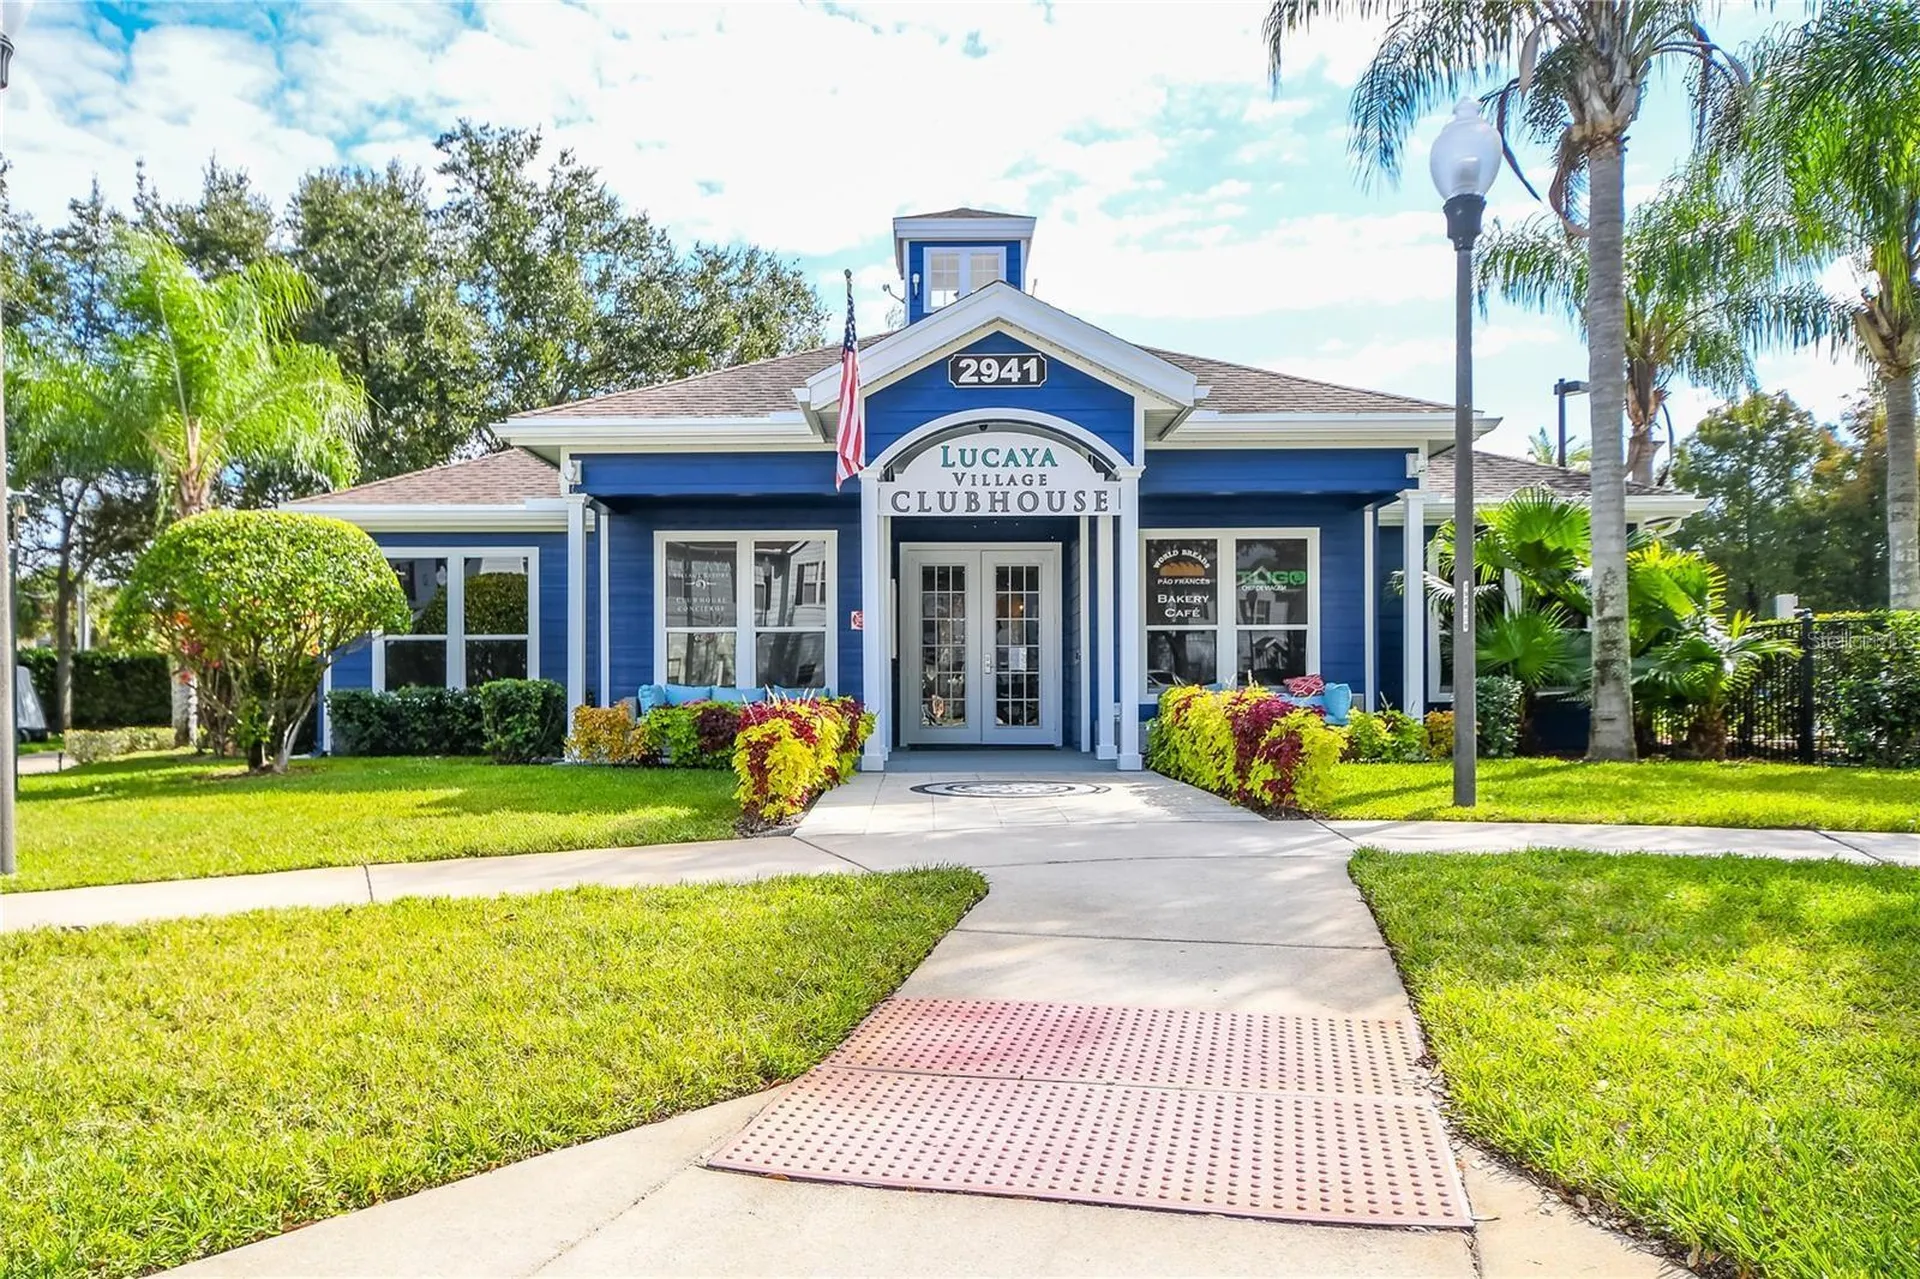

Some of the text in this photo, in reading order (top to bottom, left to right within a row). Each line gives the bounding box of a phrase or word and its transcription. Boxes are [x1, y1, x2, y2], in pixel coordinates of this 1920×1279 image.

[958, 357, 1038, 383] 2941
[941, 445, 1058, 468] LUCAYA
[952, 472, 1047, 486] VILLAGE
[891, 490, 1109, 513] CLUBHOUSE
[1153, 549, 1179, 568] WORLD
[1157, 594, 1209, 603] BAKERY
[1164, 607, 1200, 618] CAFÉ
